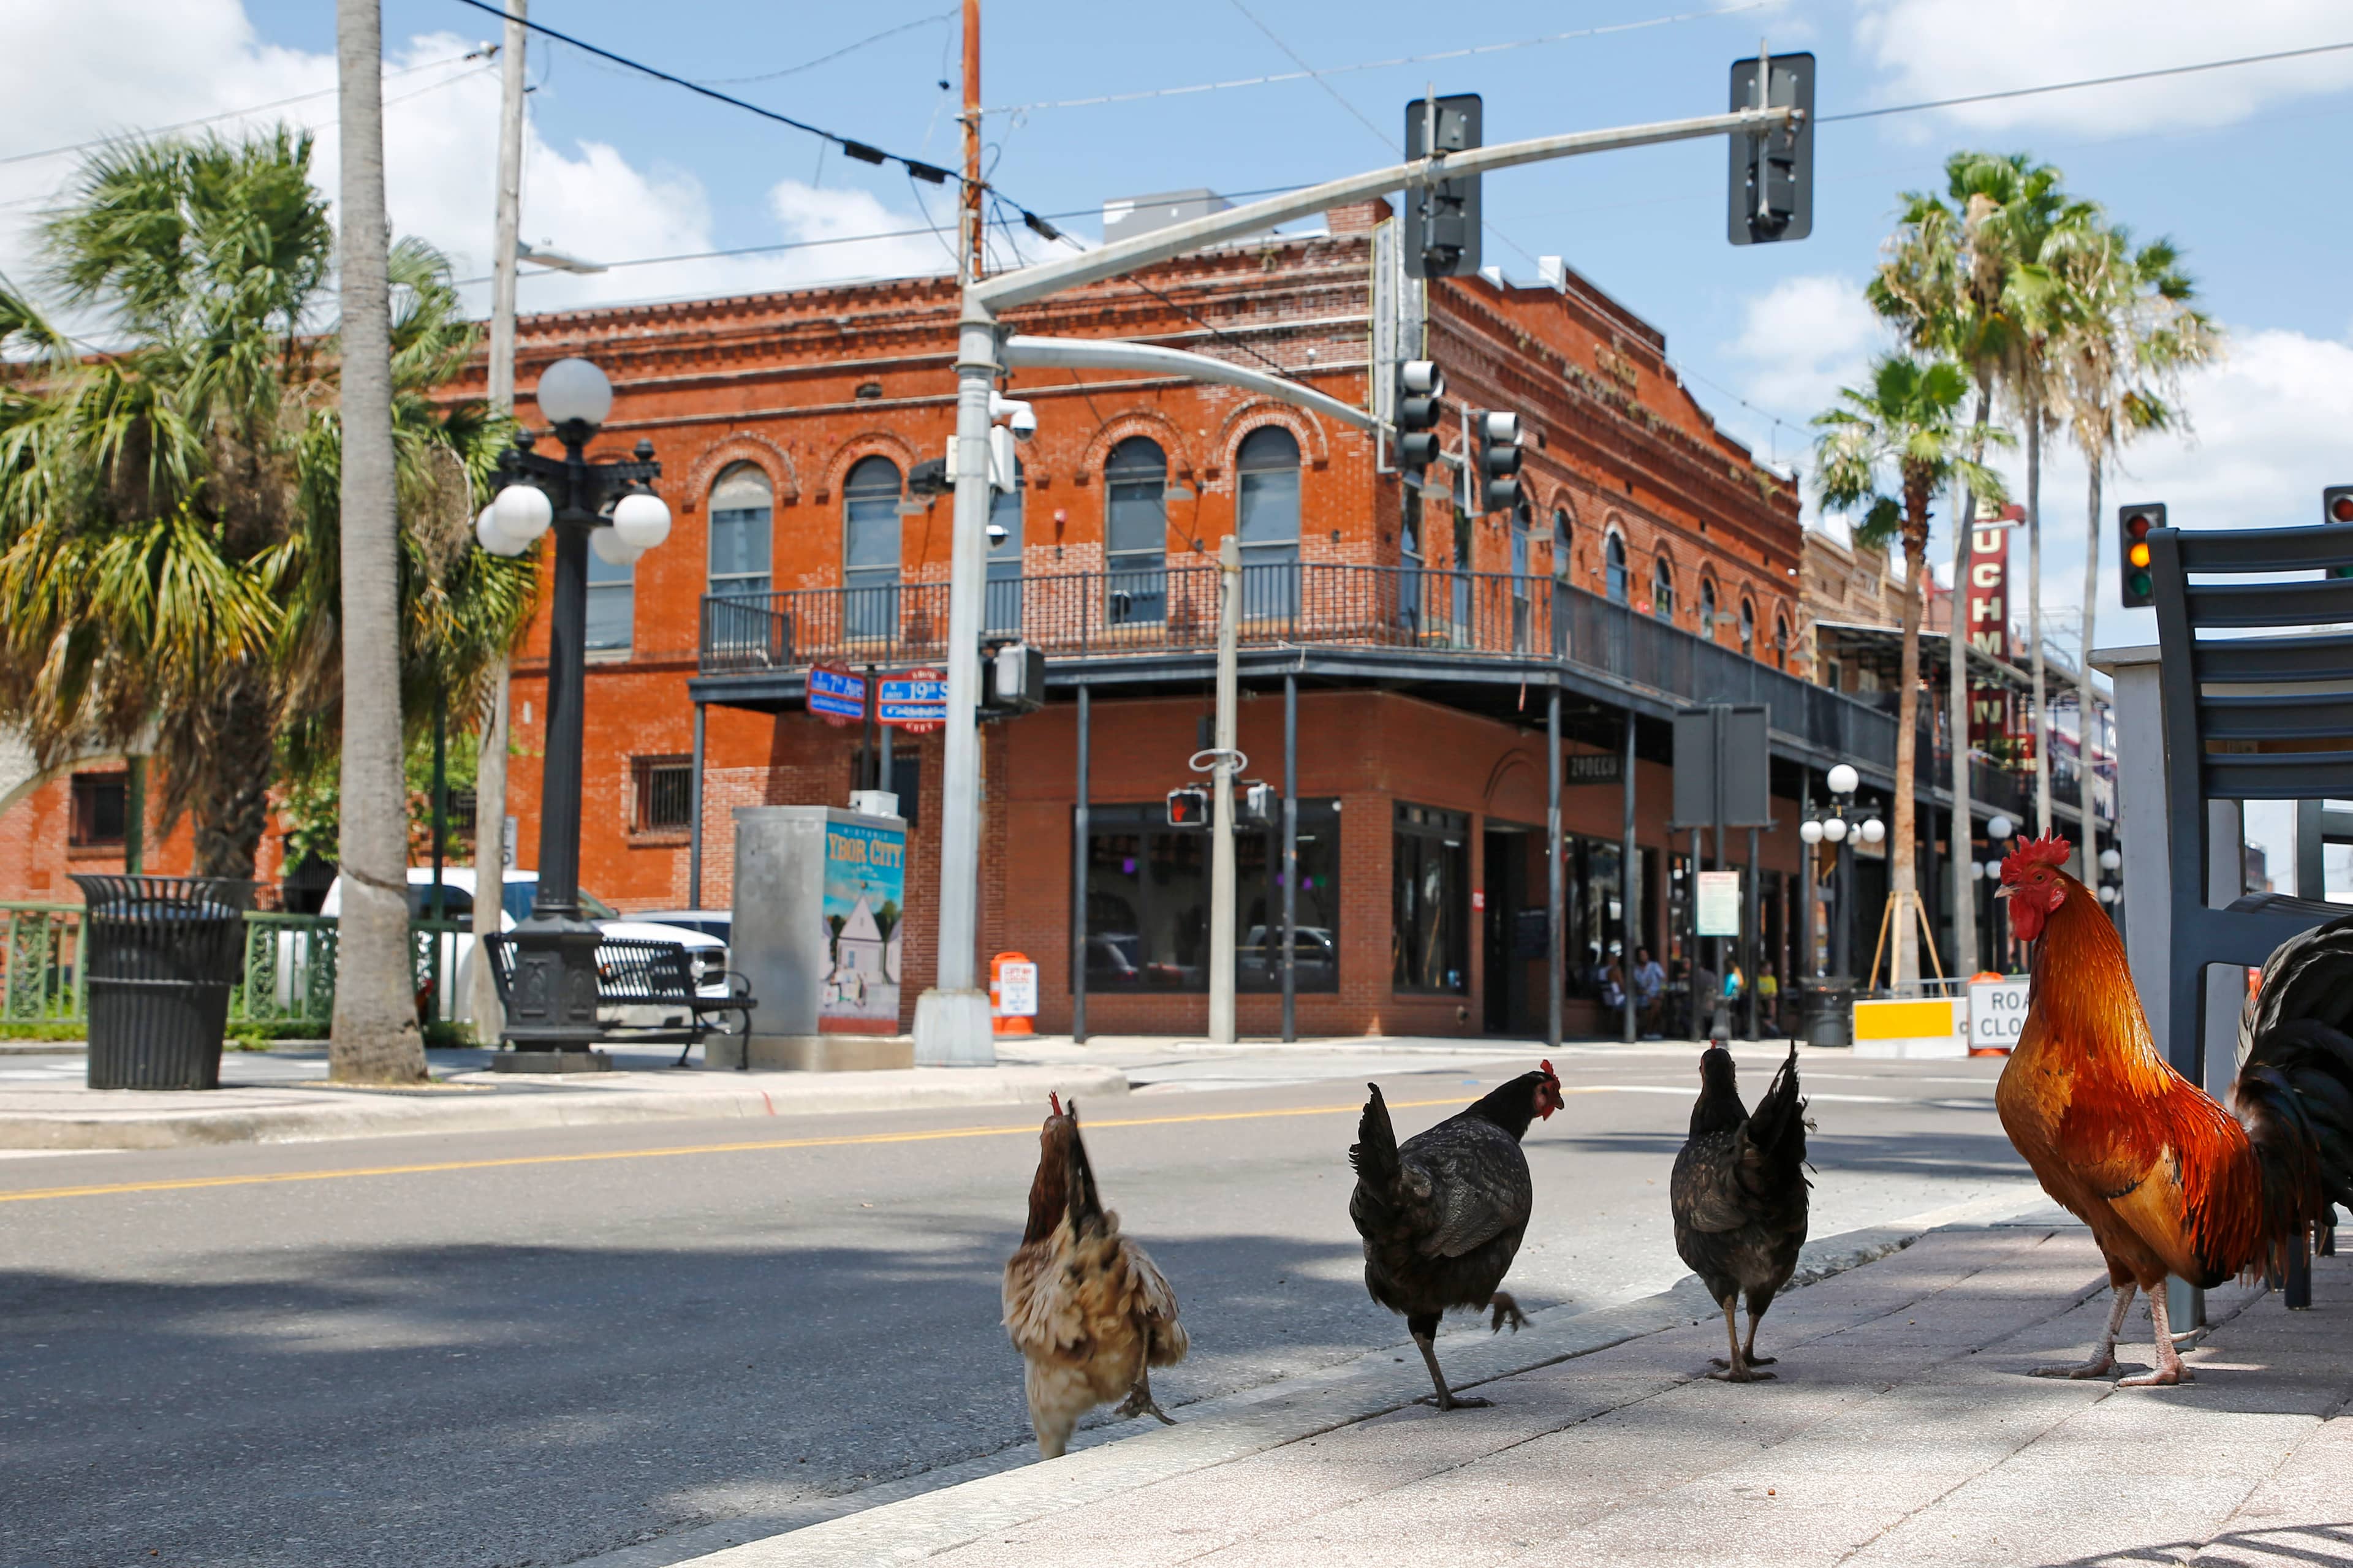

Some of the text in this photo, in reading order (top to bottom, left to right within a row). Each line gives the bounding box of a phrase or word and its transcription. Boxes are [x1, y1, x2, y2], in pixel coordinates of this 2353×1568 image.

[911, 682, 948, 700] 19th S
[828, 833, 903, 868] YBOR CITY
[1991, 991, 2029, 1010] ROA
[1980, 1017, 2022, 1037] CLO
